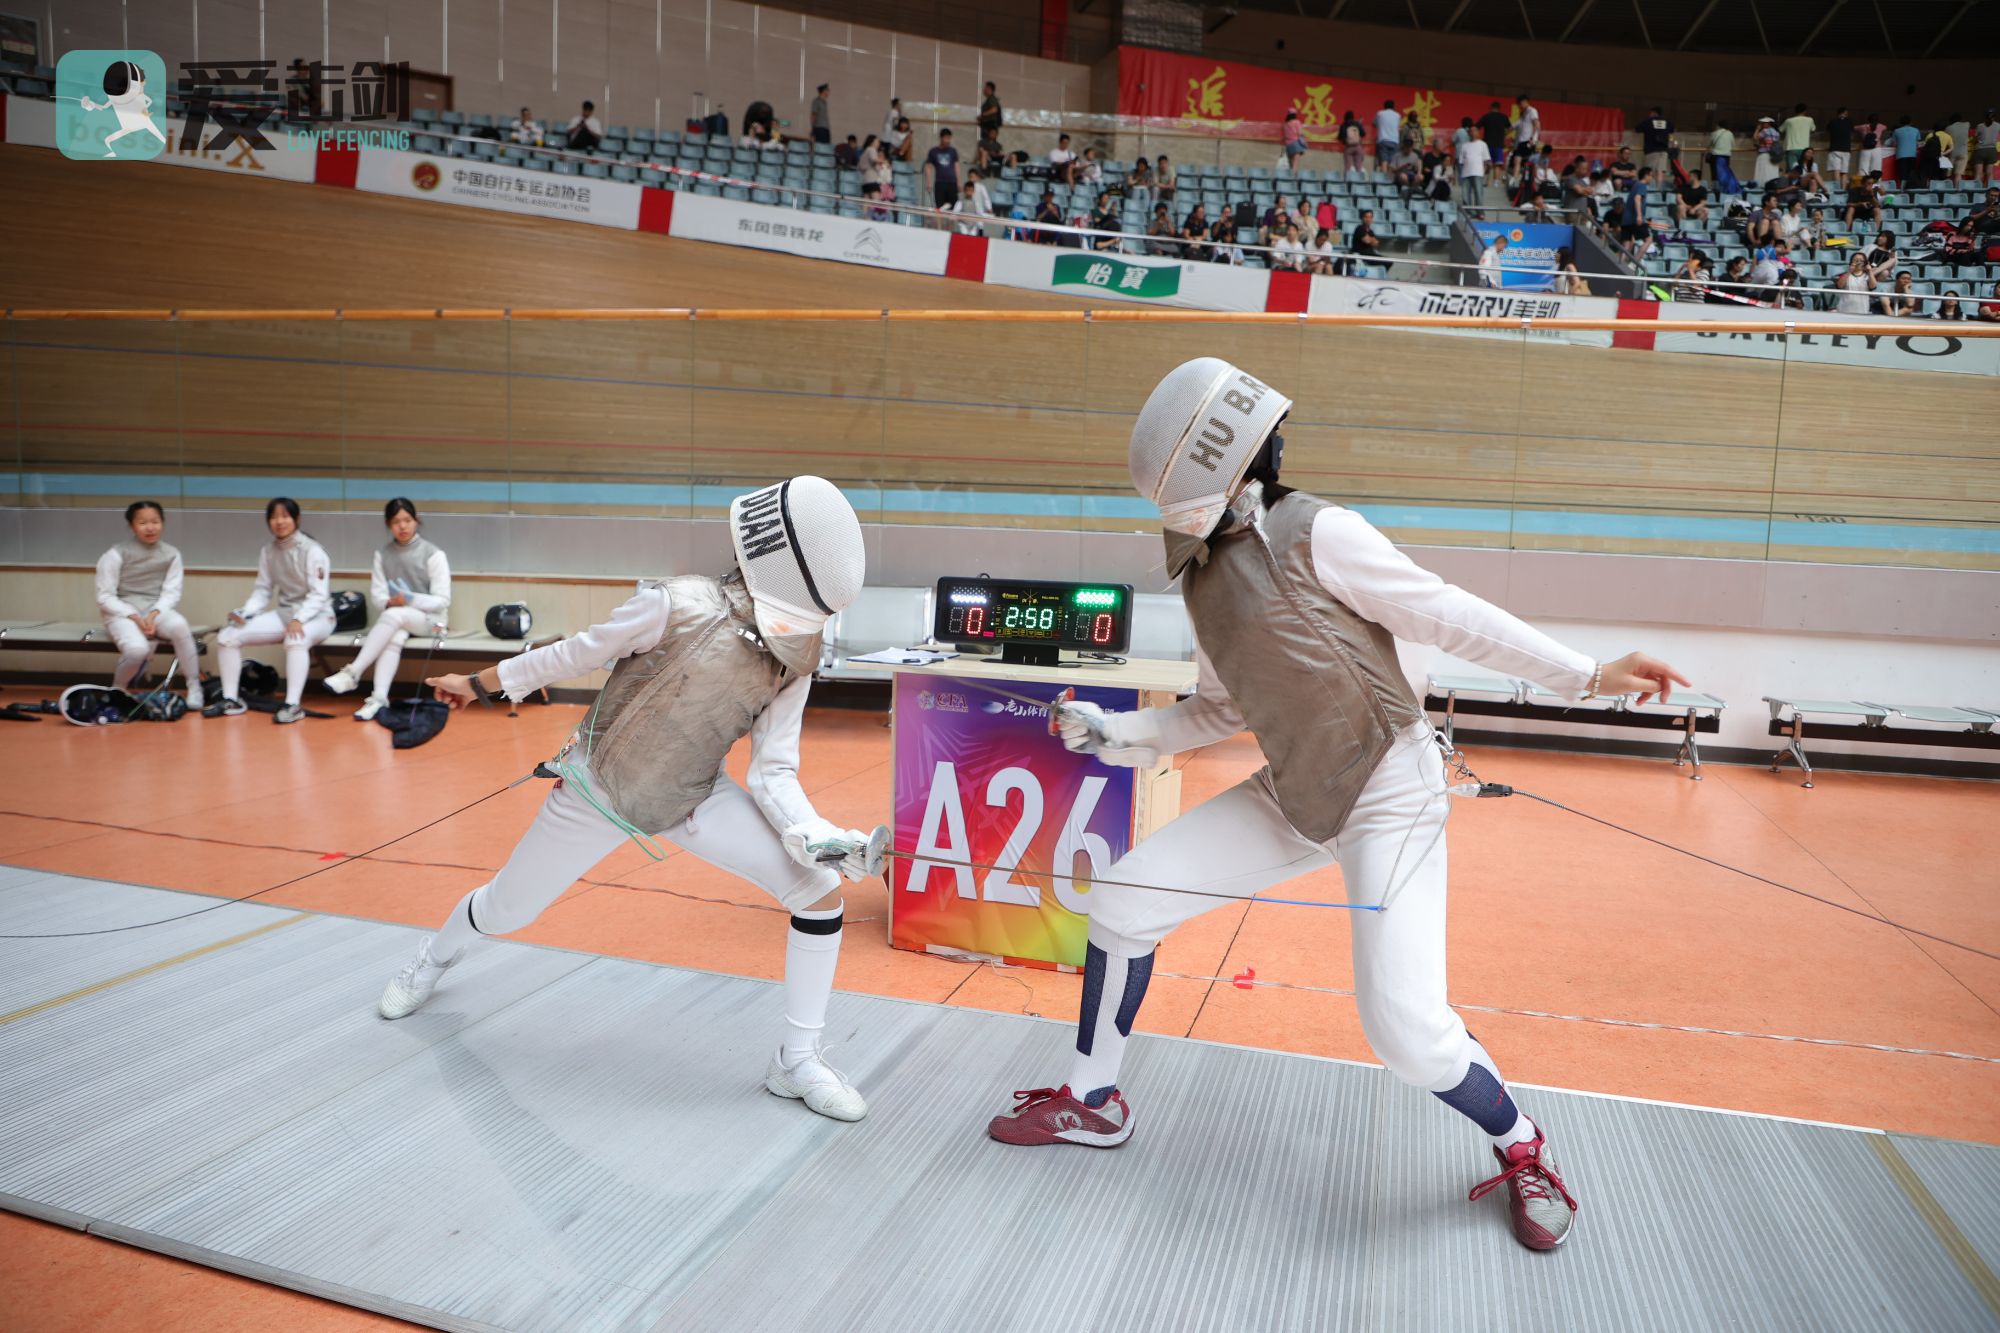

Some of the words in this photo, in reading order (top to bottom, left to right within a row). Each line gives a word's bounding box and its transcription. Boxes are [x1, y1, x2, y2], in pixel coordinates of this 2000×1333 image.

[453, 169, 591, 203] 中国自行车运动协会
[738, 218, 824, 243] 东风雪铁龙
[1189, 417, 1235, 472] HU
[739, 487, 787, 561] DUAN
[1005, 606, 1054, 630] 2:58
[936, 693, 967, 709] CFA
[905, 760, 1111, 915] A26
